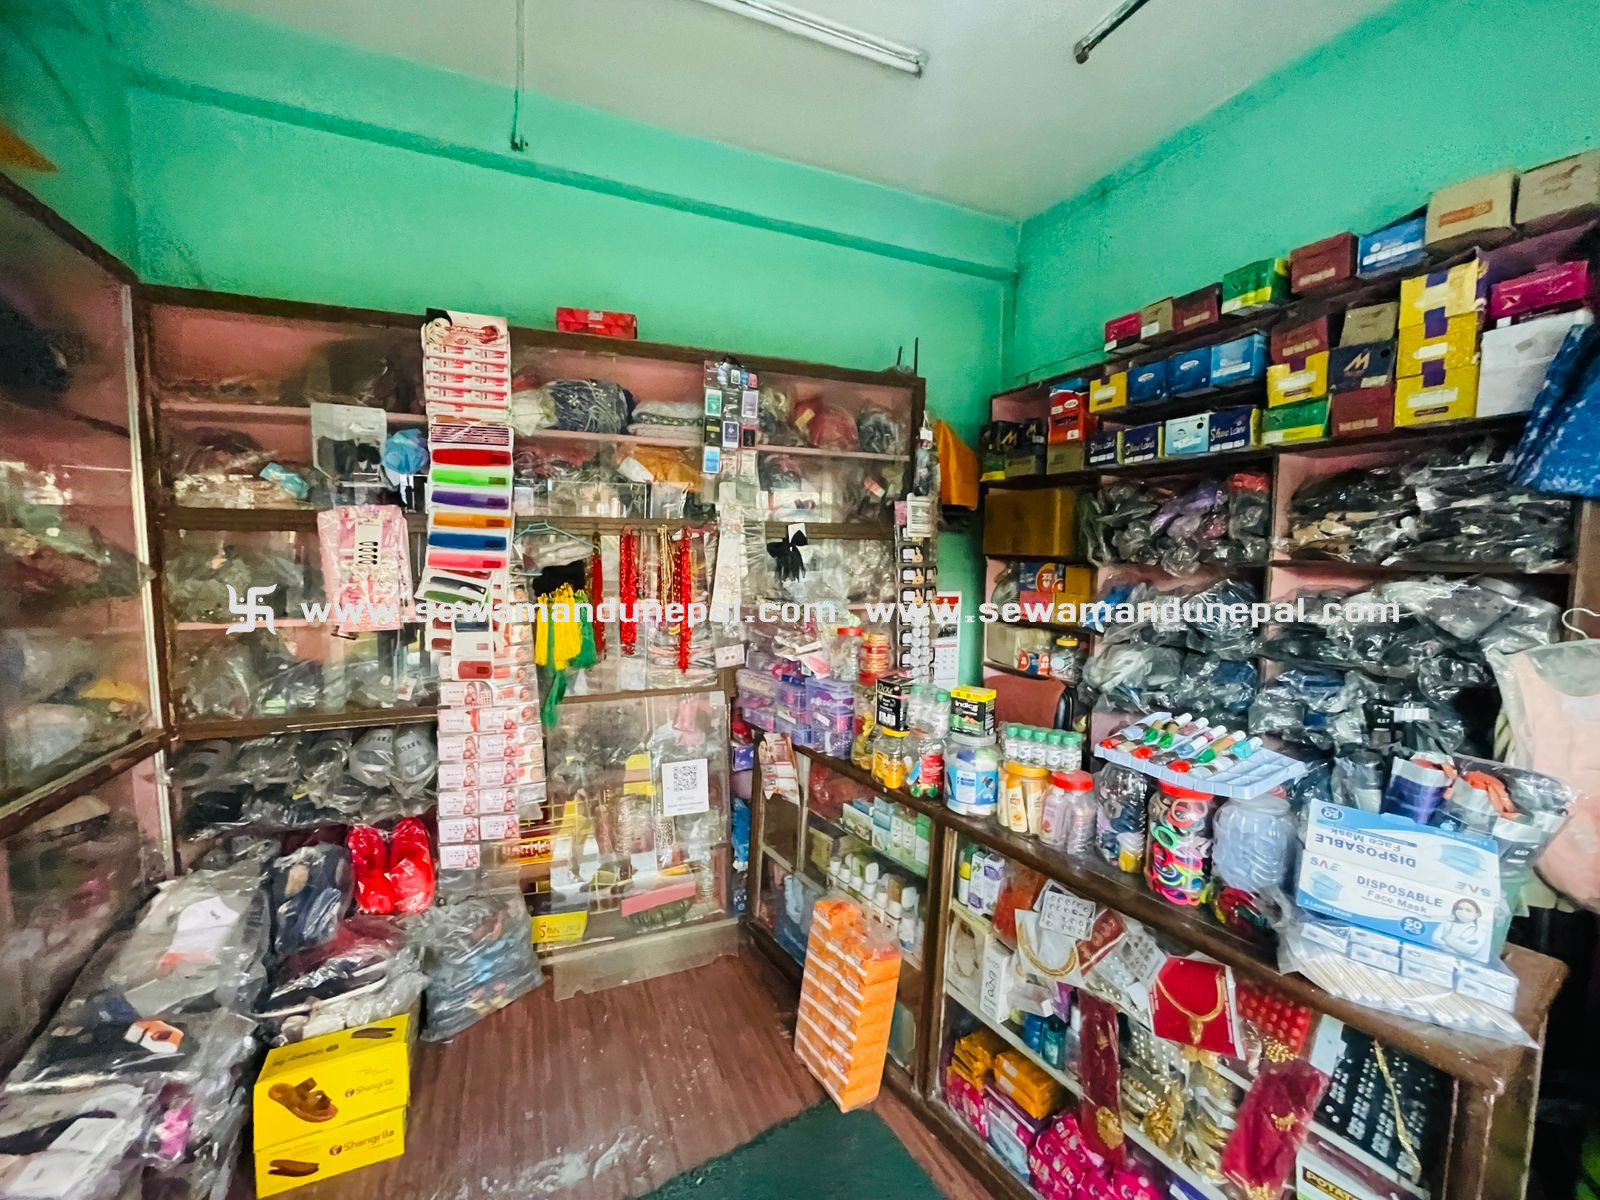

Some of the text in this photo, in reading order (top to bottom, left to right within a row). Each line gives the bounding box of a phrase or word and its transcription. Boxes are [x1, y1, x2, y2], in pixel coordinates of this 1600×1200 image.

[1315, 833, 1416, 868] DISPOSABLE
[1357, 875, 1444, 908] DISPOSABLE
[1367, 890, 1428, 913] Face Mask
[343, 1129, 395, 1151] Shangrila
